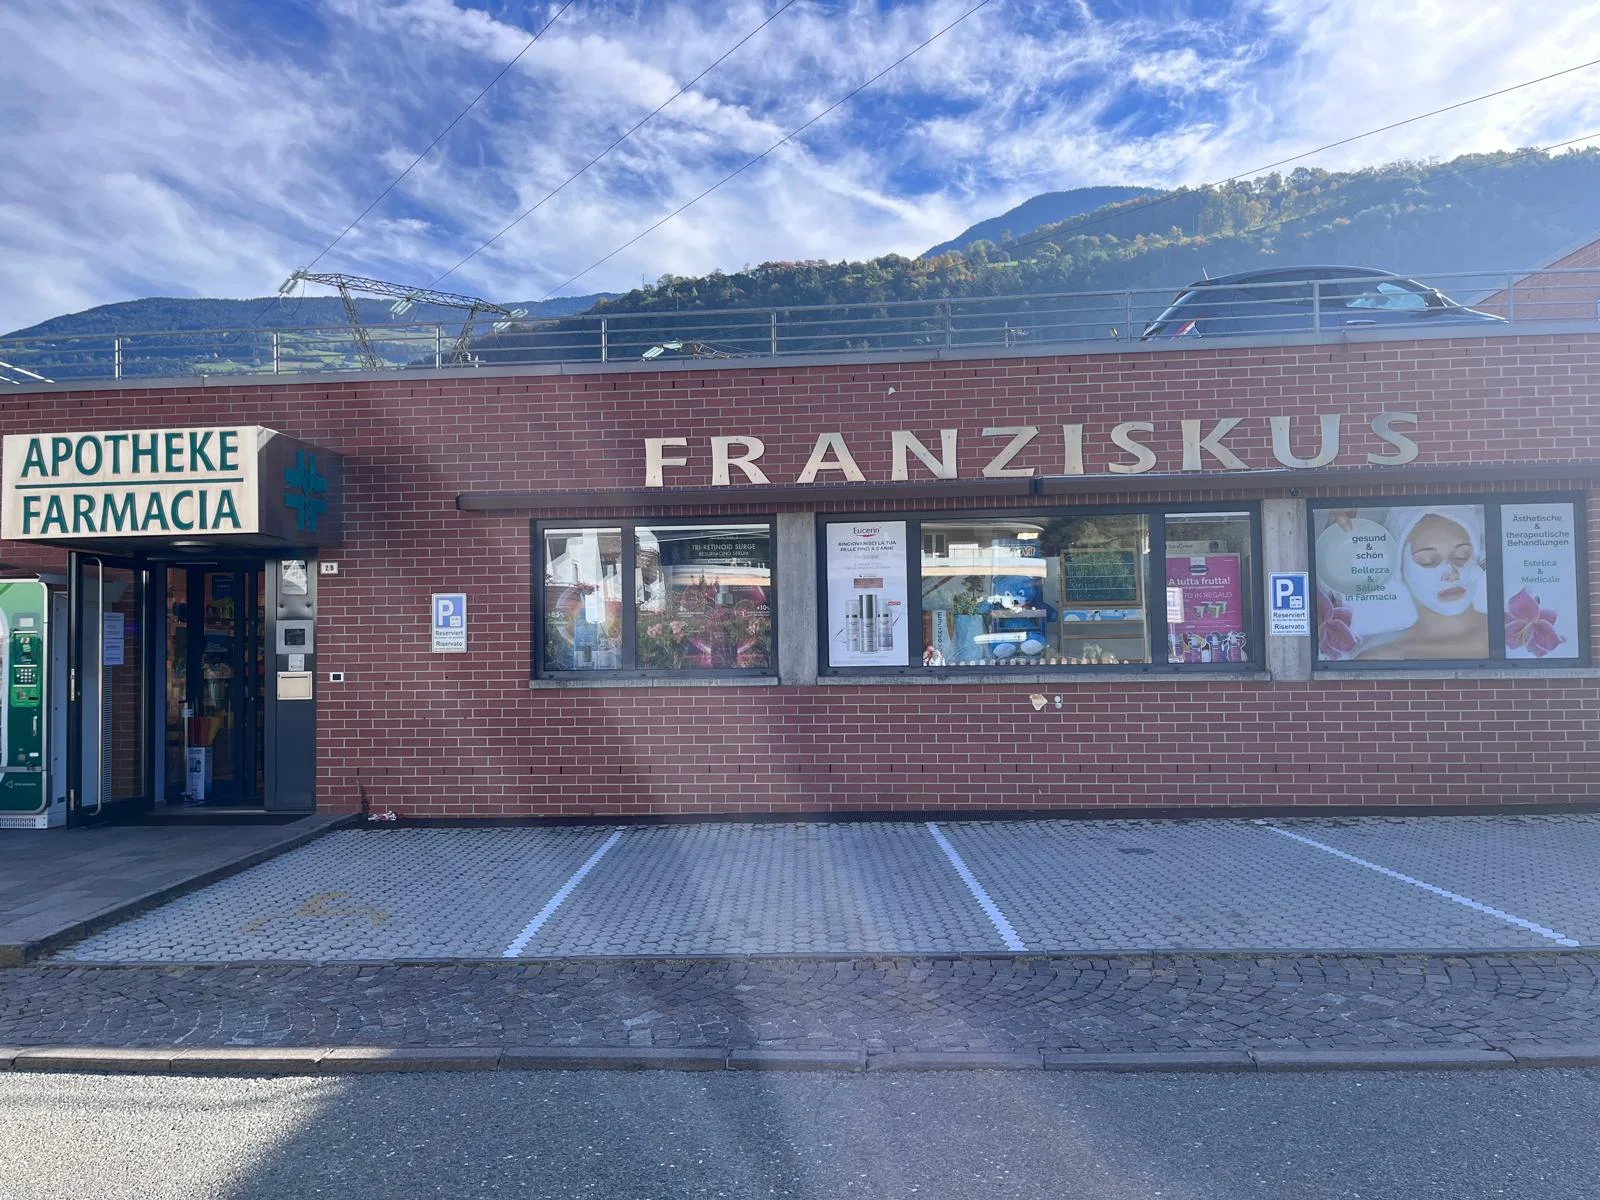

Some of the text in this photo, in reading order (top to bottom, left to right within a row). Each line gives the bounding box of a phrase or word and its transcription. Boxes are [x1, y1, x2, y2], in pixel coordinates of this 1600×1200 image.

[20, 430, 239, 478] APOTHEKE
[644, 411, 1419, 488] FRANZISKUS
[22, 489, 242, 535] FARMACIA
[1512, 513, 1562, 522] Ästhetische
[1534, 522, 1541, 530] &
[853, 527, 880, 535] Eucerin
[1506, 530, 1570, 539] therapeutische
[1352, 534, 1386, 544] gesund
[1507, 539, 1569, 548] Behandlungen
[691, 543, 733, 551] TRI-RETINOID
[1366, 543, 1373, 551] &
[1523, 559, 1557, 567] Estetica
[1351, 566, 1390, 574] Bellezza
[1201, 576, 1231, 585] frutta!
[1276, 579, 1294, 607] P
[1356, 593, 1397, 601] Farmacia
[438, 599, 454, 626] P
